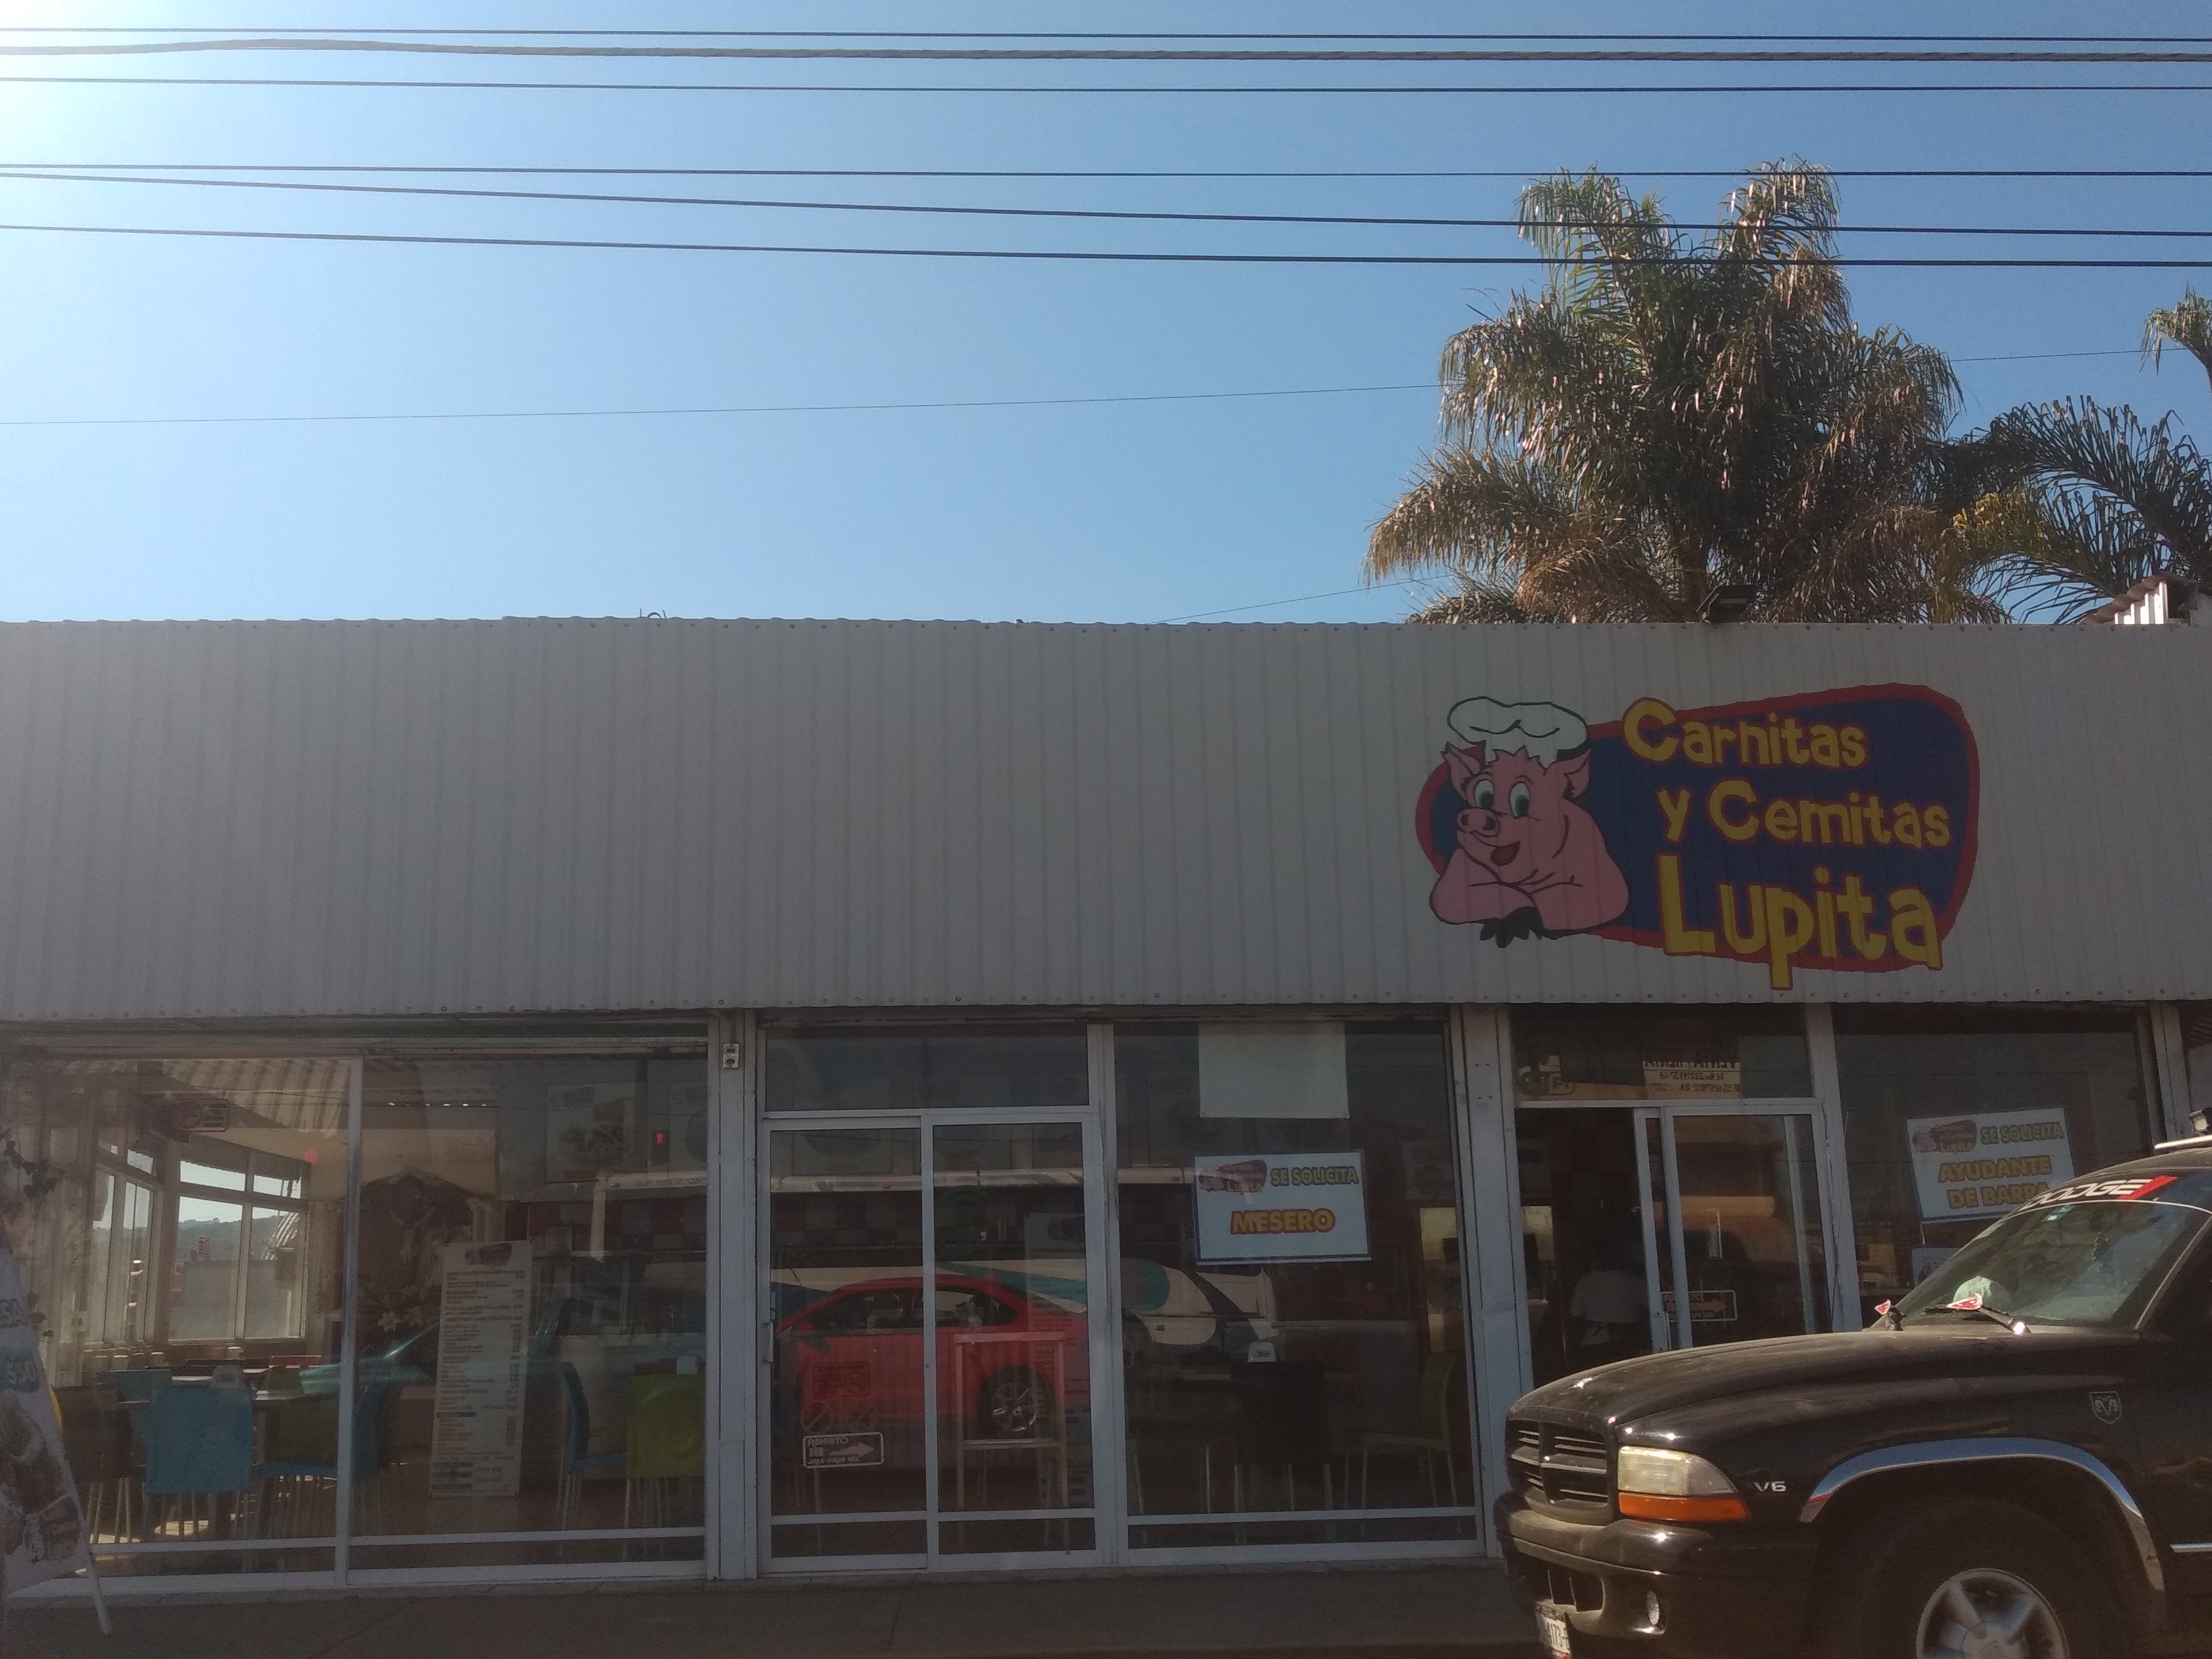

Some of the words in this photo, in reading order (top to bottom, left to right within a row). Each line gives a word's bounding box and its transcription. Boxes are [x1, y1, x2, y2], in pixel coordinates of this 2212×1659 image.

[1622, 697, 1866, 767] Carnitas
[1708, 778, 1951, 848] Cemitas
[1657, 853, 1943, 991] Lupita
[1980, 1126, 1998, 1145] SE
[2000, 1121, 2065, 1143] SOLICITA
[1270, 1168, 1289, 1186] SE
[1292, 1166, 1360, 1186] SOLICITA
[1938, 1155, 2052, 1183] AYUDANTE
[1947, 1188, 1979, 1210] DE
[2017, 1178, 2154, 1212] DODGE
[1230, 1208, 1336, 1235] MESERO
[1753, 1480, 1788, 1492] V6
